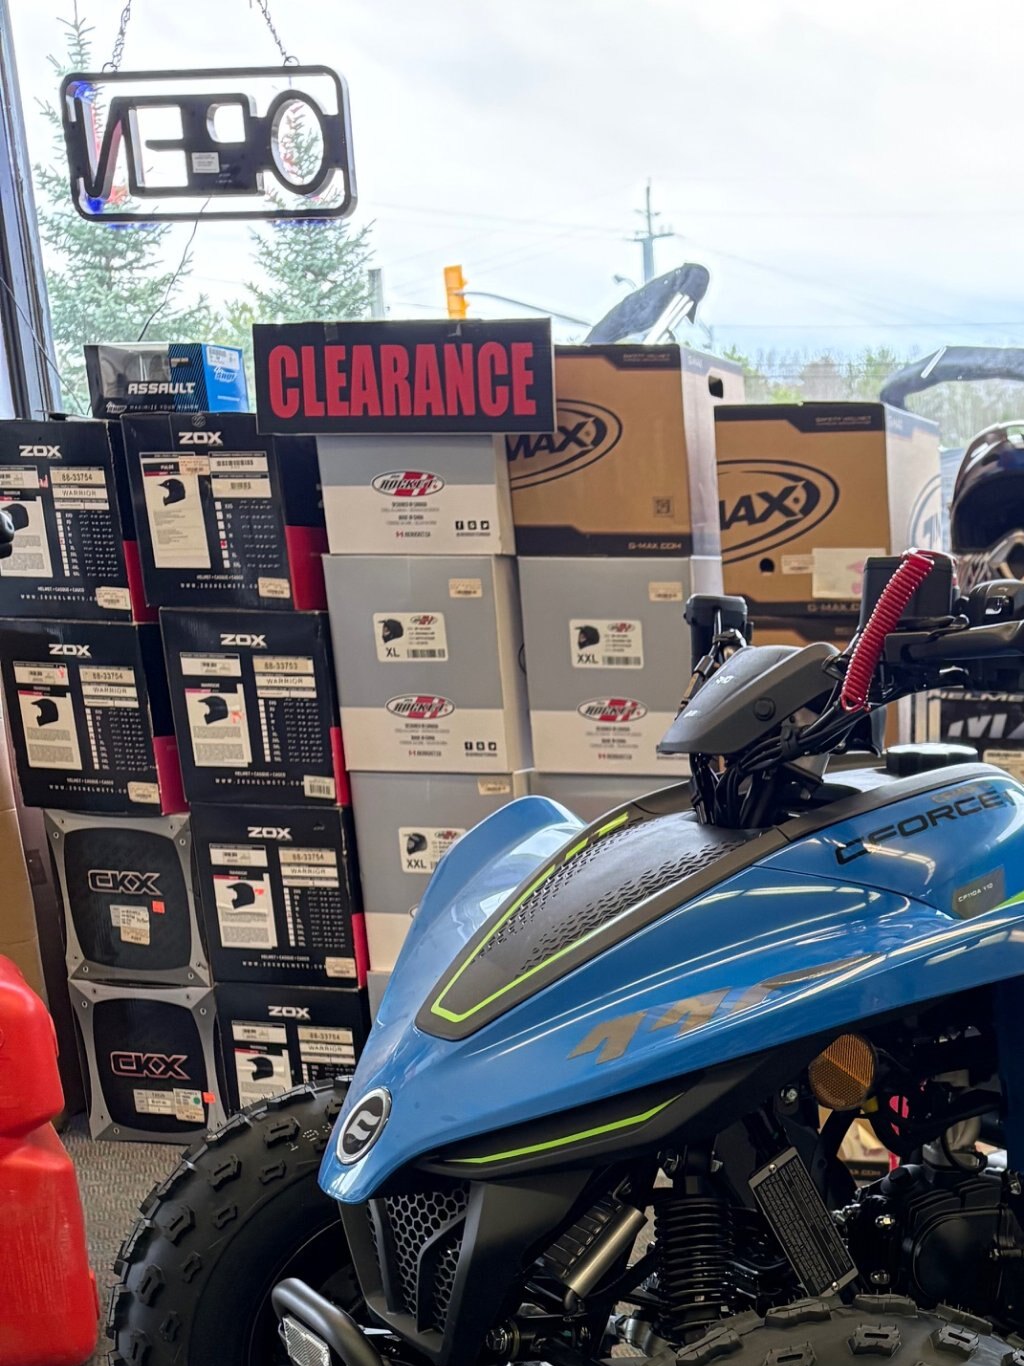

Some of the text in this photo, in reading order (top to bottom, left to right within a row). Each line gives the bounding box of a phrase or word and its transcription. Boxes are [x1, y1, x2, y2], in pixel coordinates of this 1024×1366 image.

[268, 341, 537, 418] CLEARANCE
[128, 382, 196, 395] ASSAULT
[178, 431, 223, 446] ZOX
[505, 417, 594, 461] MAX
[19, 445, 62, 459] ZOX
[61, 473, 93, 481] 88-33754
[808, 603, 860, 612] G-MAX.C
[220, 634, 268, 648] ZOX
[48, 644, 92, 658] ZOX
[386, 647, 400, 658] XL
[577, 654, 599, 664] XXL
[247, 826, 293, 840] ZOX
[835, 788, 1005, 865] CFORCE
[407, 859, 427, 869] XXL
[88, 869, 163, 896] CKX
[268, 1006, 311, 1020] ZOX
[110, 1051, 191, 1080] CKX
